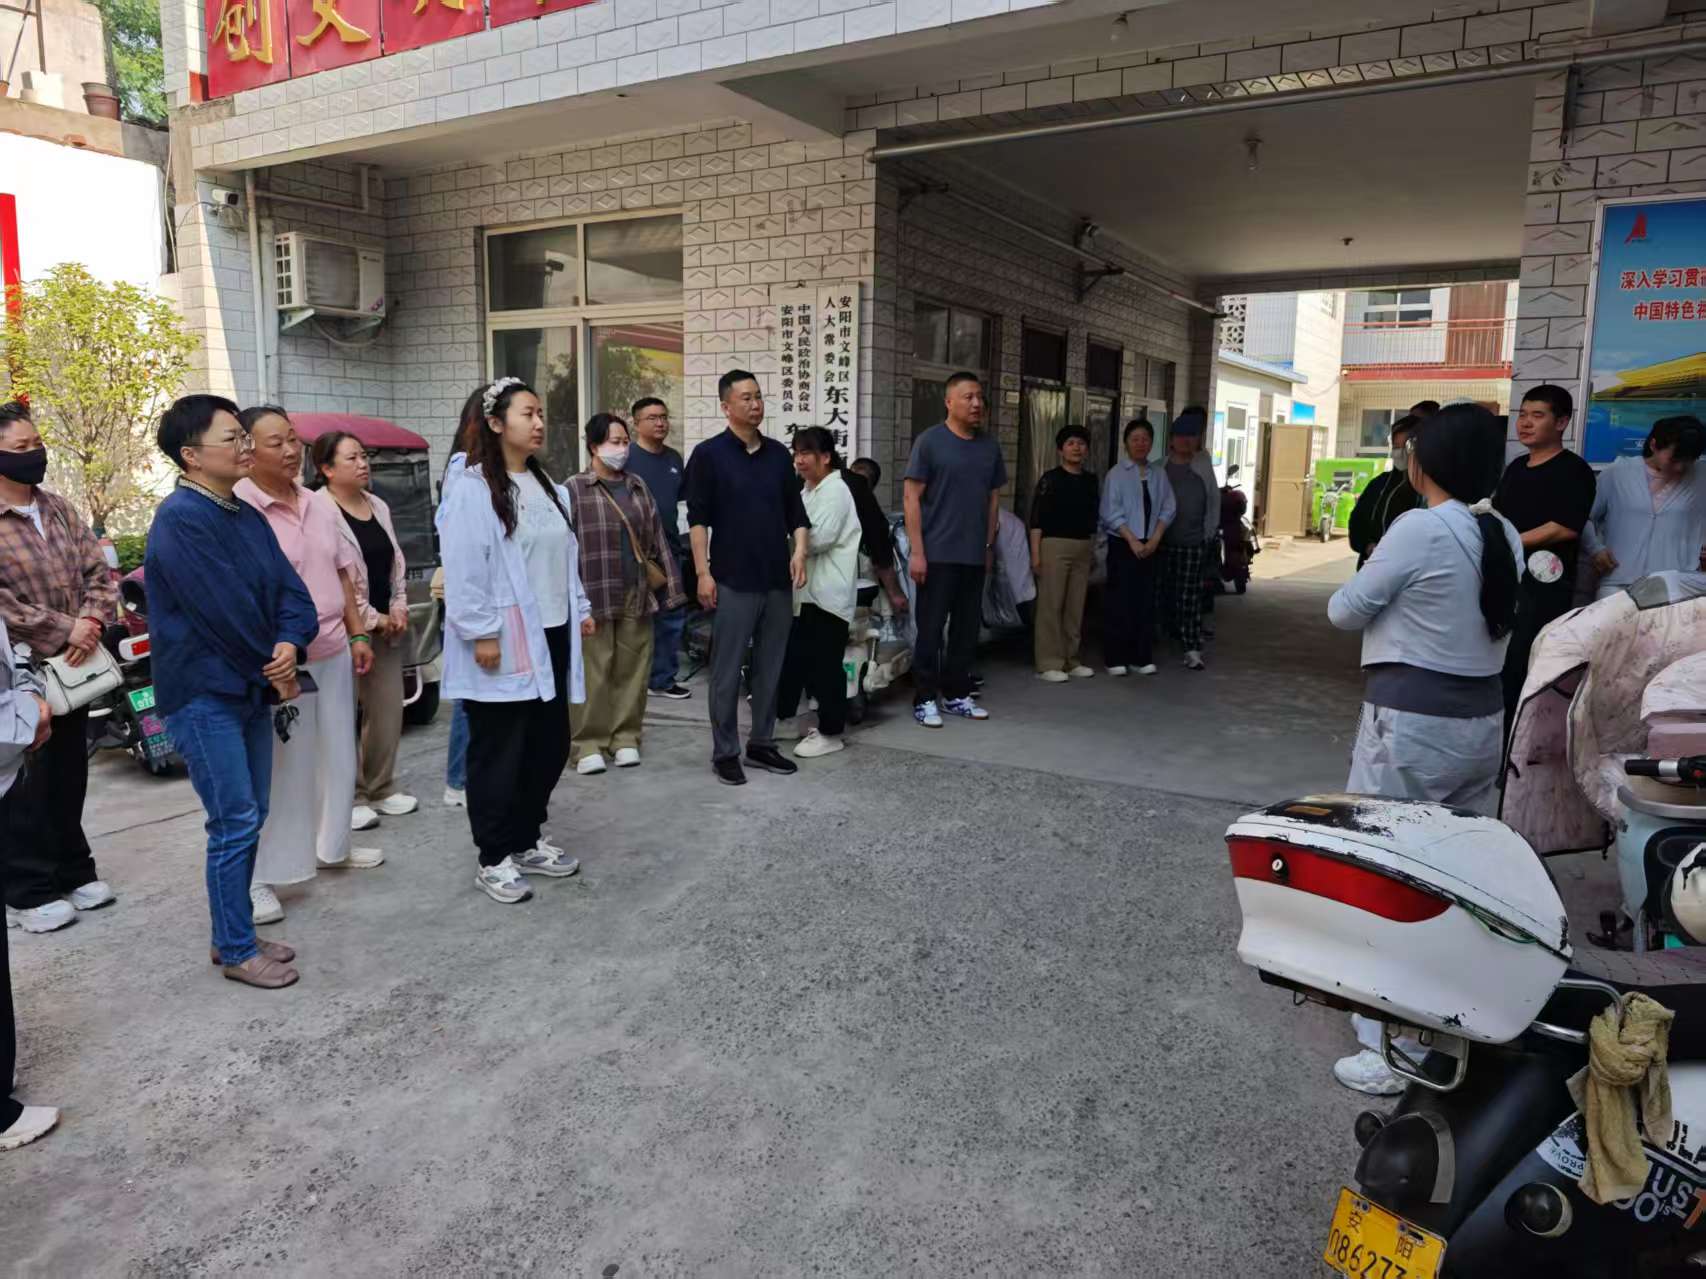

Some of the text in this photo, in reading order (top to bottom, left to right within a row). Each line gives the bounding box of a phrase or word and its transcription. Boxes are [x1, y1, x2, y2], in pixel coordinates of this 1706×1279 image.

[781, 304, 794, 413] 安阳市文峰区委员会
[797, 303, 811, 413] 中国人民政治协商会议
[823, 295, 836, 383] 人大常委会
[838, 295, 852, 383] 安阳市文峰区
